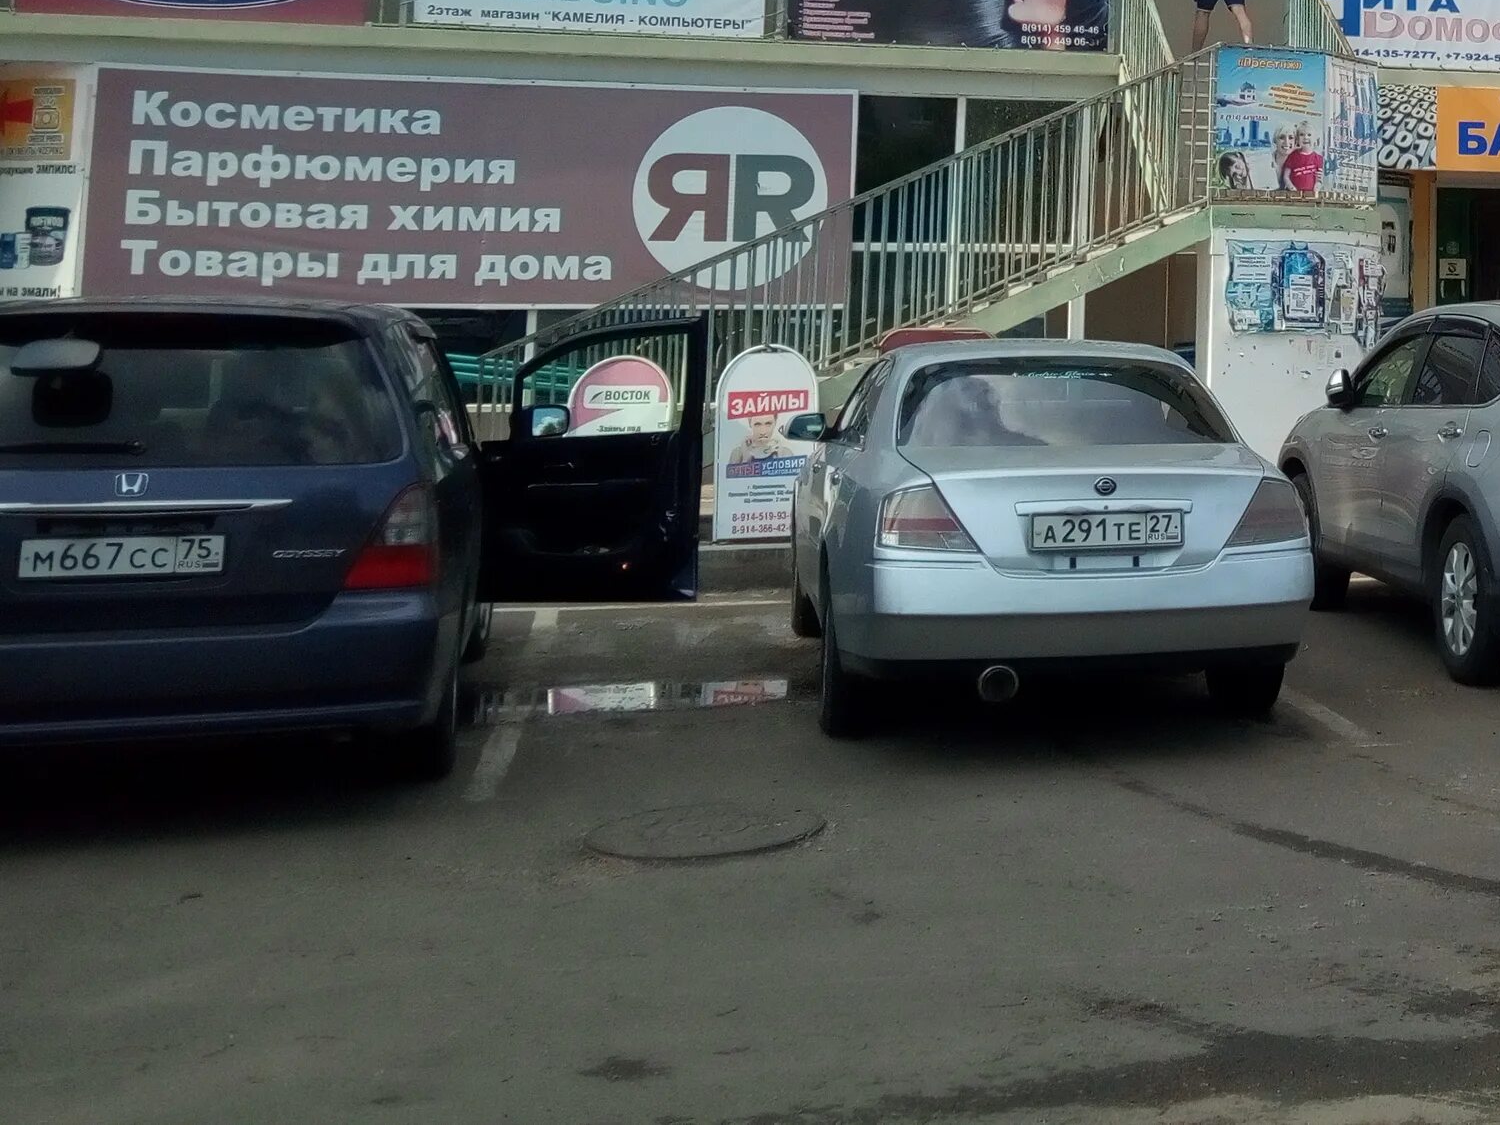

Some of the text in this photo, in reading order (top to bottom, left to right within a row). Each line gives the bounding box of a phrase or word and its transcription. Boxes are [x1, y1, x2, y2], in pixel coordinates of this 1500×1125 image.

[427, 4, 473, 18] 2этаж
[480, 10, 540, 22] магазин
[1021, 23, 1100, 34] 8(914) 459 46-46
[1021, 34, 1072, 45] 8(914) 449
[1353, 48, 1441, 61] 14-135-7277,
[131, 90, 441, 136] Косметика
[127, 139, 516, 191] Парфюмерия
[124, 189, 561, 233] Бытовая химия
[120, 239, 613, 287] Товары для дома
[6, 285, 62, 298] на эмали!
[604, 390, 651, 401] ВОСТОК
[731, 392, 805, 416] ЗАЙМЫ
[761, 456, 806, 471] УСЛОВИЯ
[732, 512, 792, 523] 8-914-519-93-
[731, 524, 792, 535] 8-914-366-42-
[1042, 514, 1173, 544] А291ТЕ 27
[1147, 533, 1166, 541] RUS
[32, 538, 212, 573] М667СС 75
[178, 560, 201, 570] RUS
